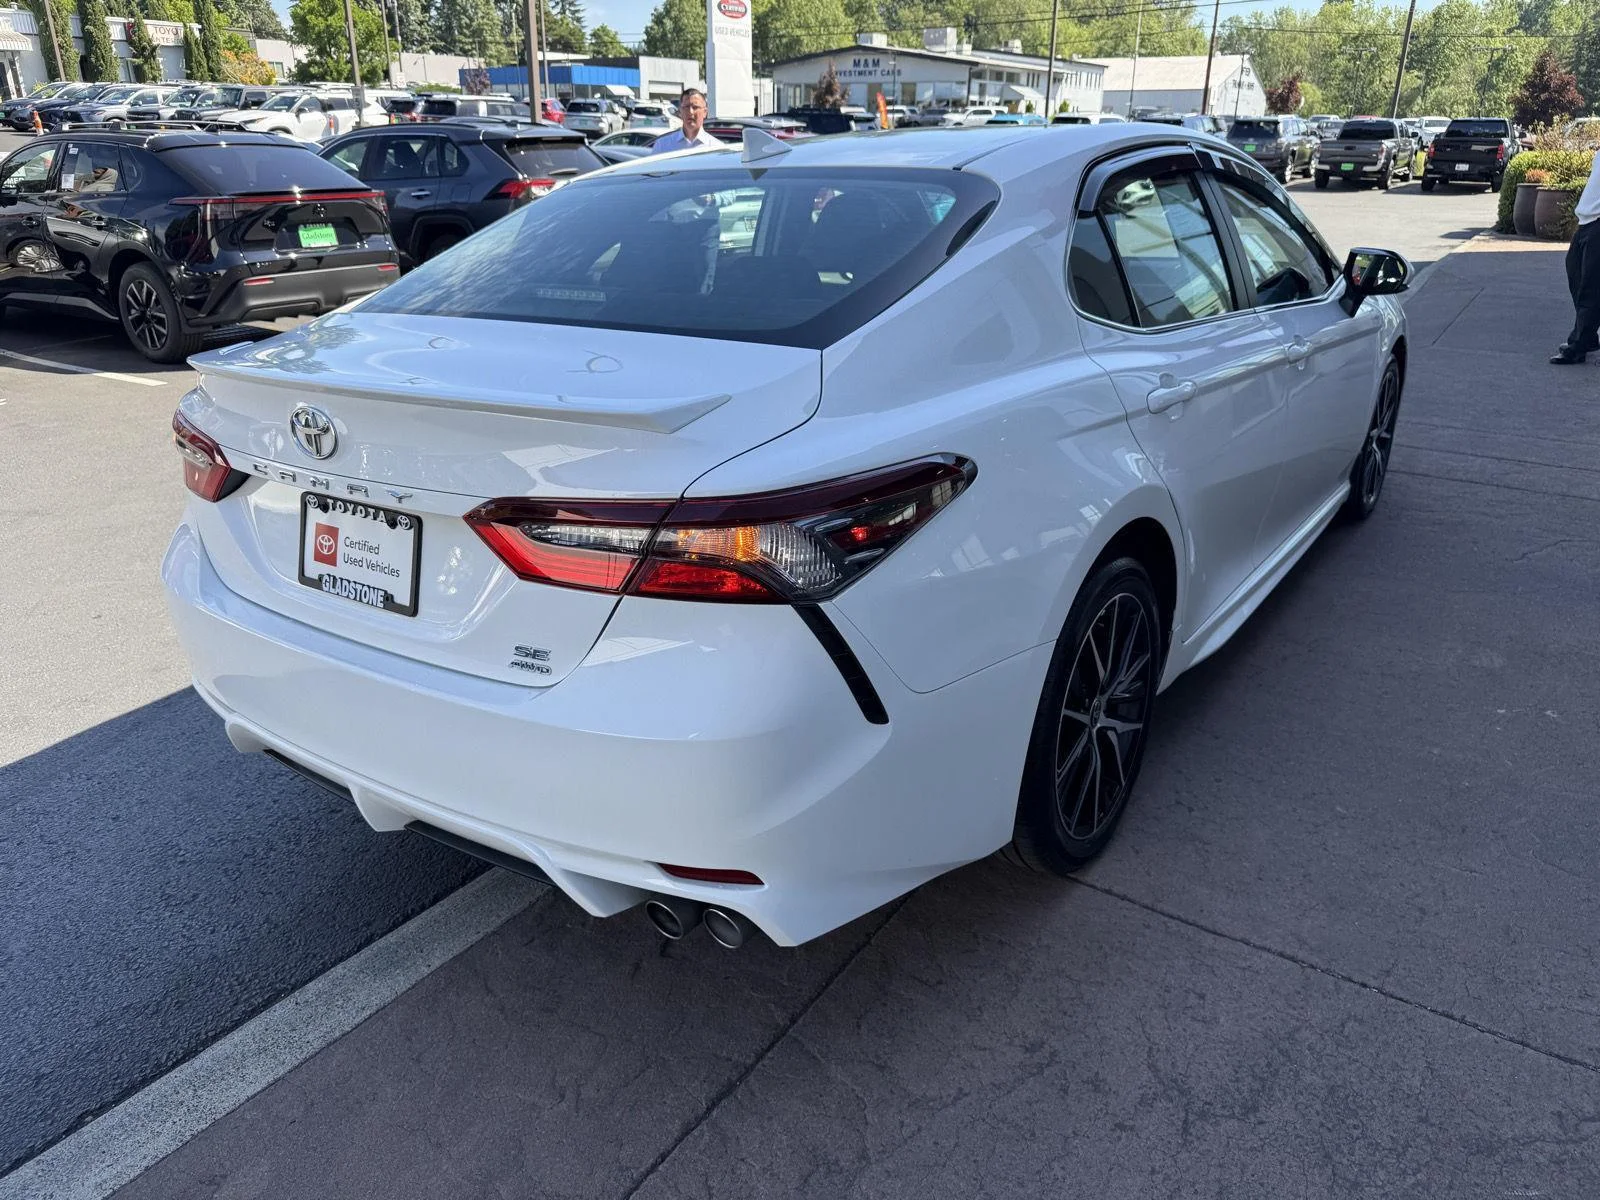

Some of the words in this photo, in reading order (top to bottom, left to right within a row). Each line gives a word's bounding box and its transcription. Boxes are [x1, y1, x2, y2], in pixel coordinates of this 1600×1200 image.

[154, 26, 184, 36] TOYOT
[853, 58, 861, 68] M
[863, 58, 869, 68] &
[872, 58, 880, 68] M
[834, 69, 877, 77] NVESTMENT
[252, 463, 413, 504] CAMRY
[326, 499, 387, 524] TOYOTA
[343, 536, 380, 555] Certified
[343, 552, 364, 568] Used
[365, 558, 401, 578] Vehicles
[322, 574, 386, 608] GLADSTONE
[513, 645, 551, 661] SE
[510, 660, 551, 675] AWD
